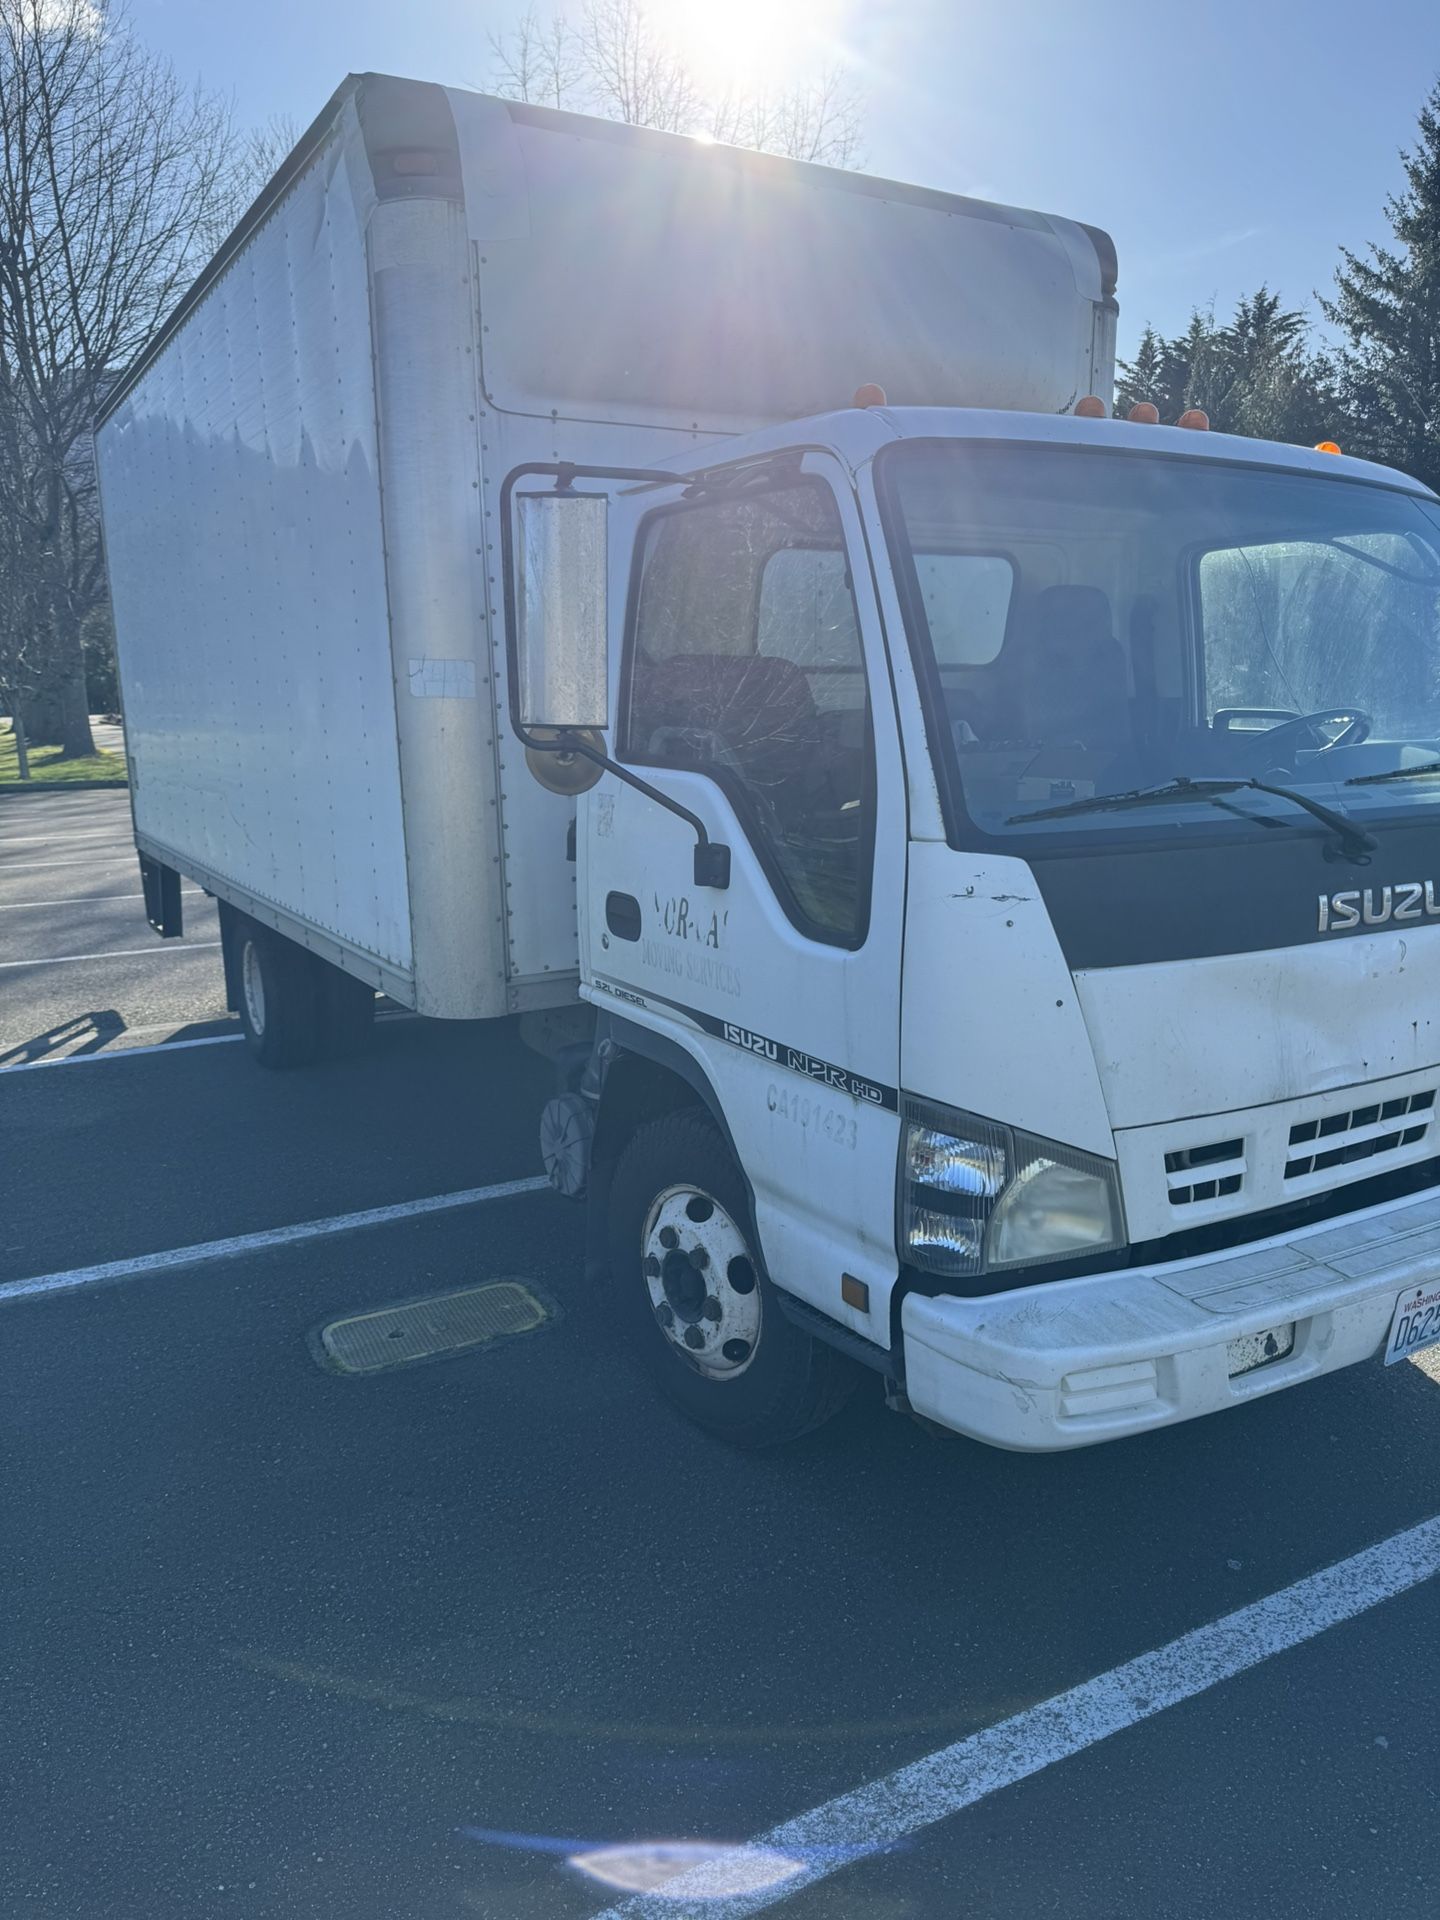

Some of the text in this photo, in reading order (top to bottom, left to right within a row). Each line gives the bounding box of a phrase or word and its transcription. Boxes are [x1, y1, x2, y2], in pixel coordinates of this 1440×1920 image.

[614, 987, 648, 1008] DIESEL
[724, 1023, 882, 1104] ISUZU NPR HD
